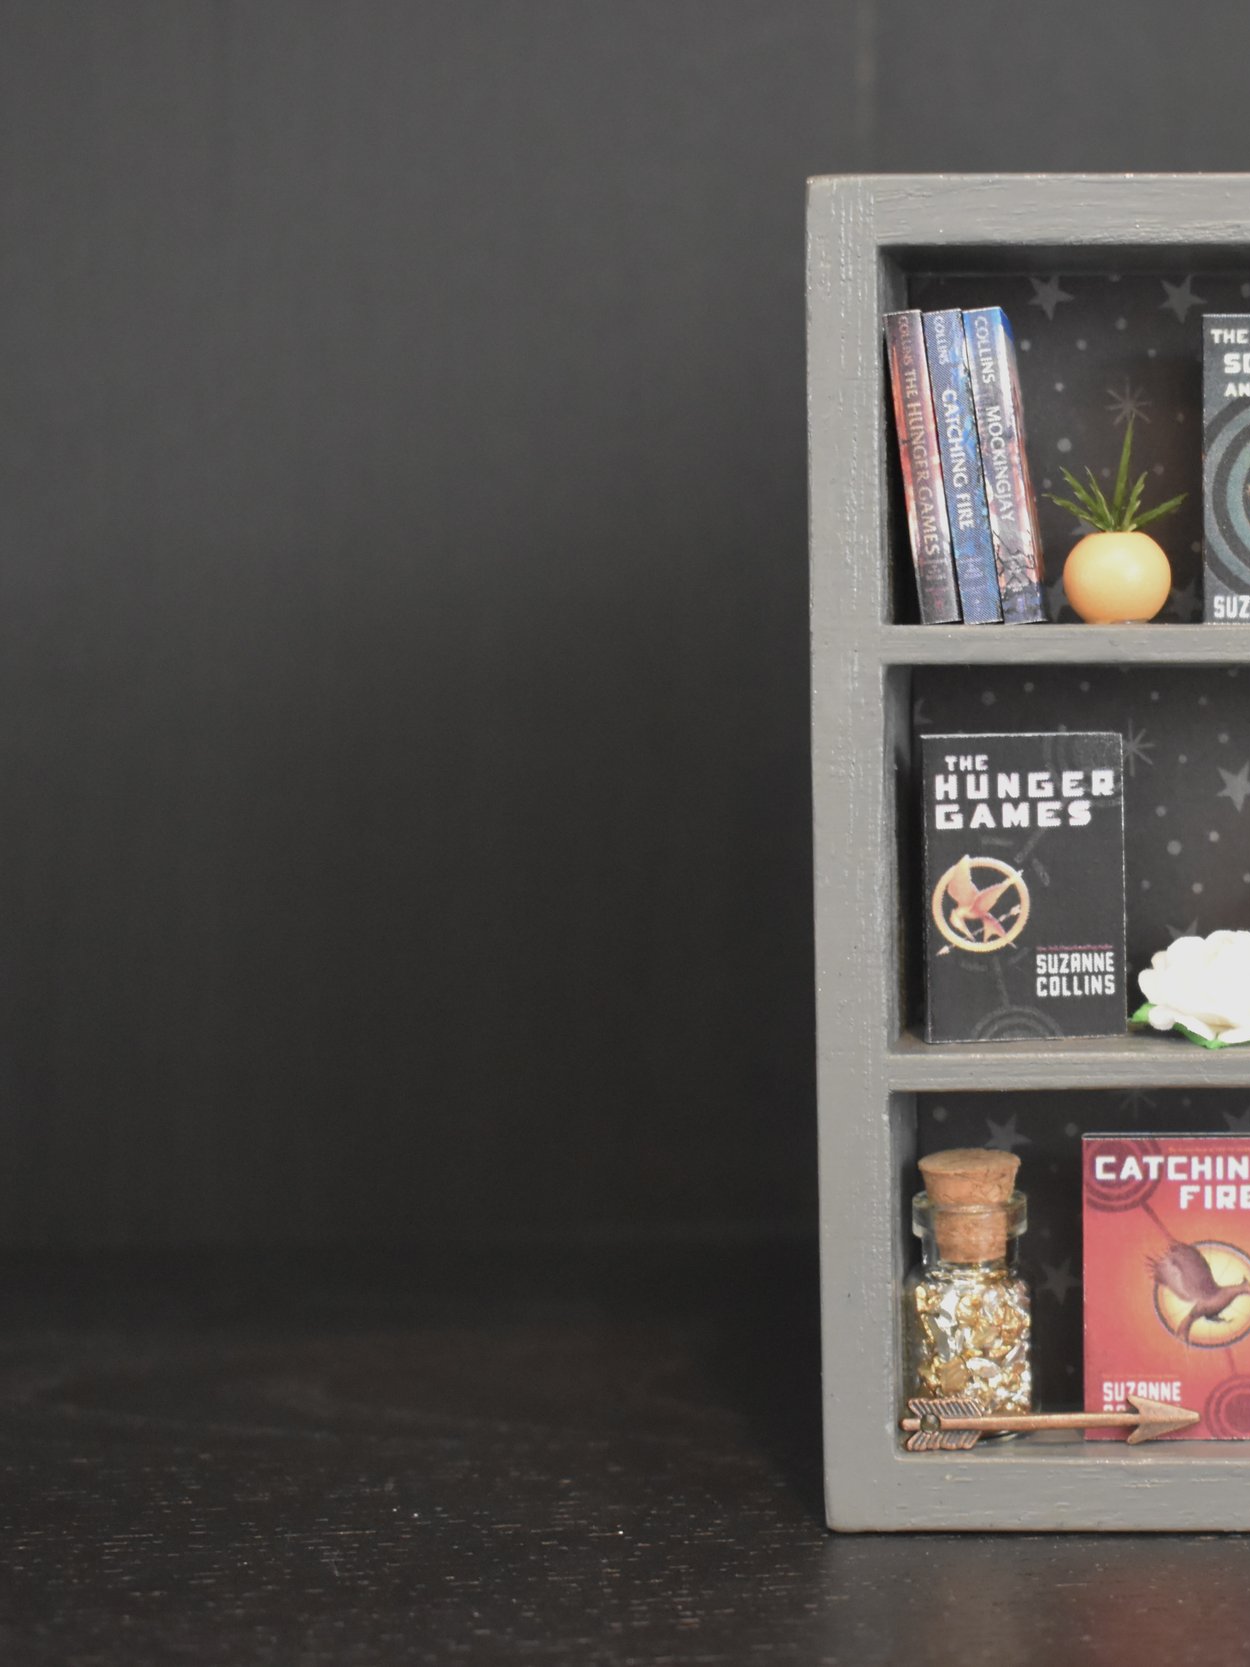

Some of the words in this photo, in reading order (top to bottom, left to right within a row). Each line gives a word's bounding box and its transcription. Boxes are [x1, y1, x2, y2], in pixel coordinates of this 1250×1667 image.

[1211, 329, 1249, 345] THE
[904, 369, 918, 398] THE
[975, 316, 995, 384] COLLINS
[985, 406, 1015, 521] MOCKINGJAY
[907, 403, 930, 481] HUNGER
[941, 389, 969, 488] CATCHING
[956, 492, 975, 531] FIRE
[918, 486, 940, 555] GAMES
[944, 755, 989, 772] THE
[935, 770, 1115, 800] HUNGER
[935, 800, 1092, 830] GAMES
[1036, 952, 1115, 974] SUZANNE
[1036, 974, 1115, 997] COLLINS
[1103, 1381, 1182, 1402] SUZANNE
